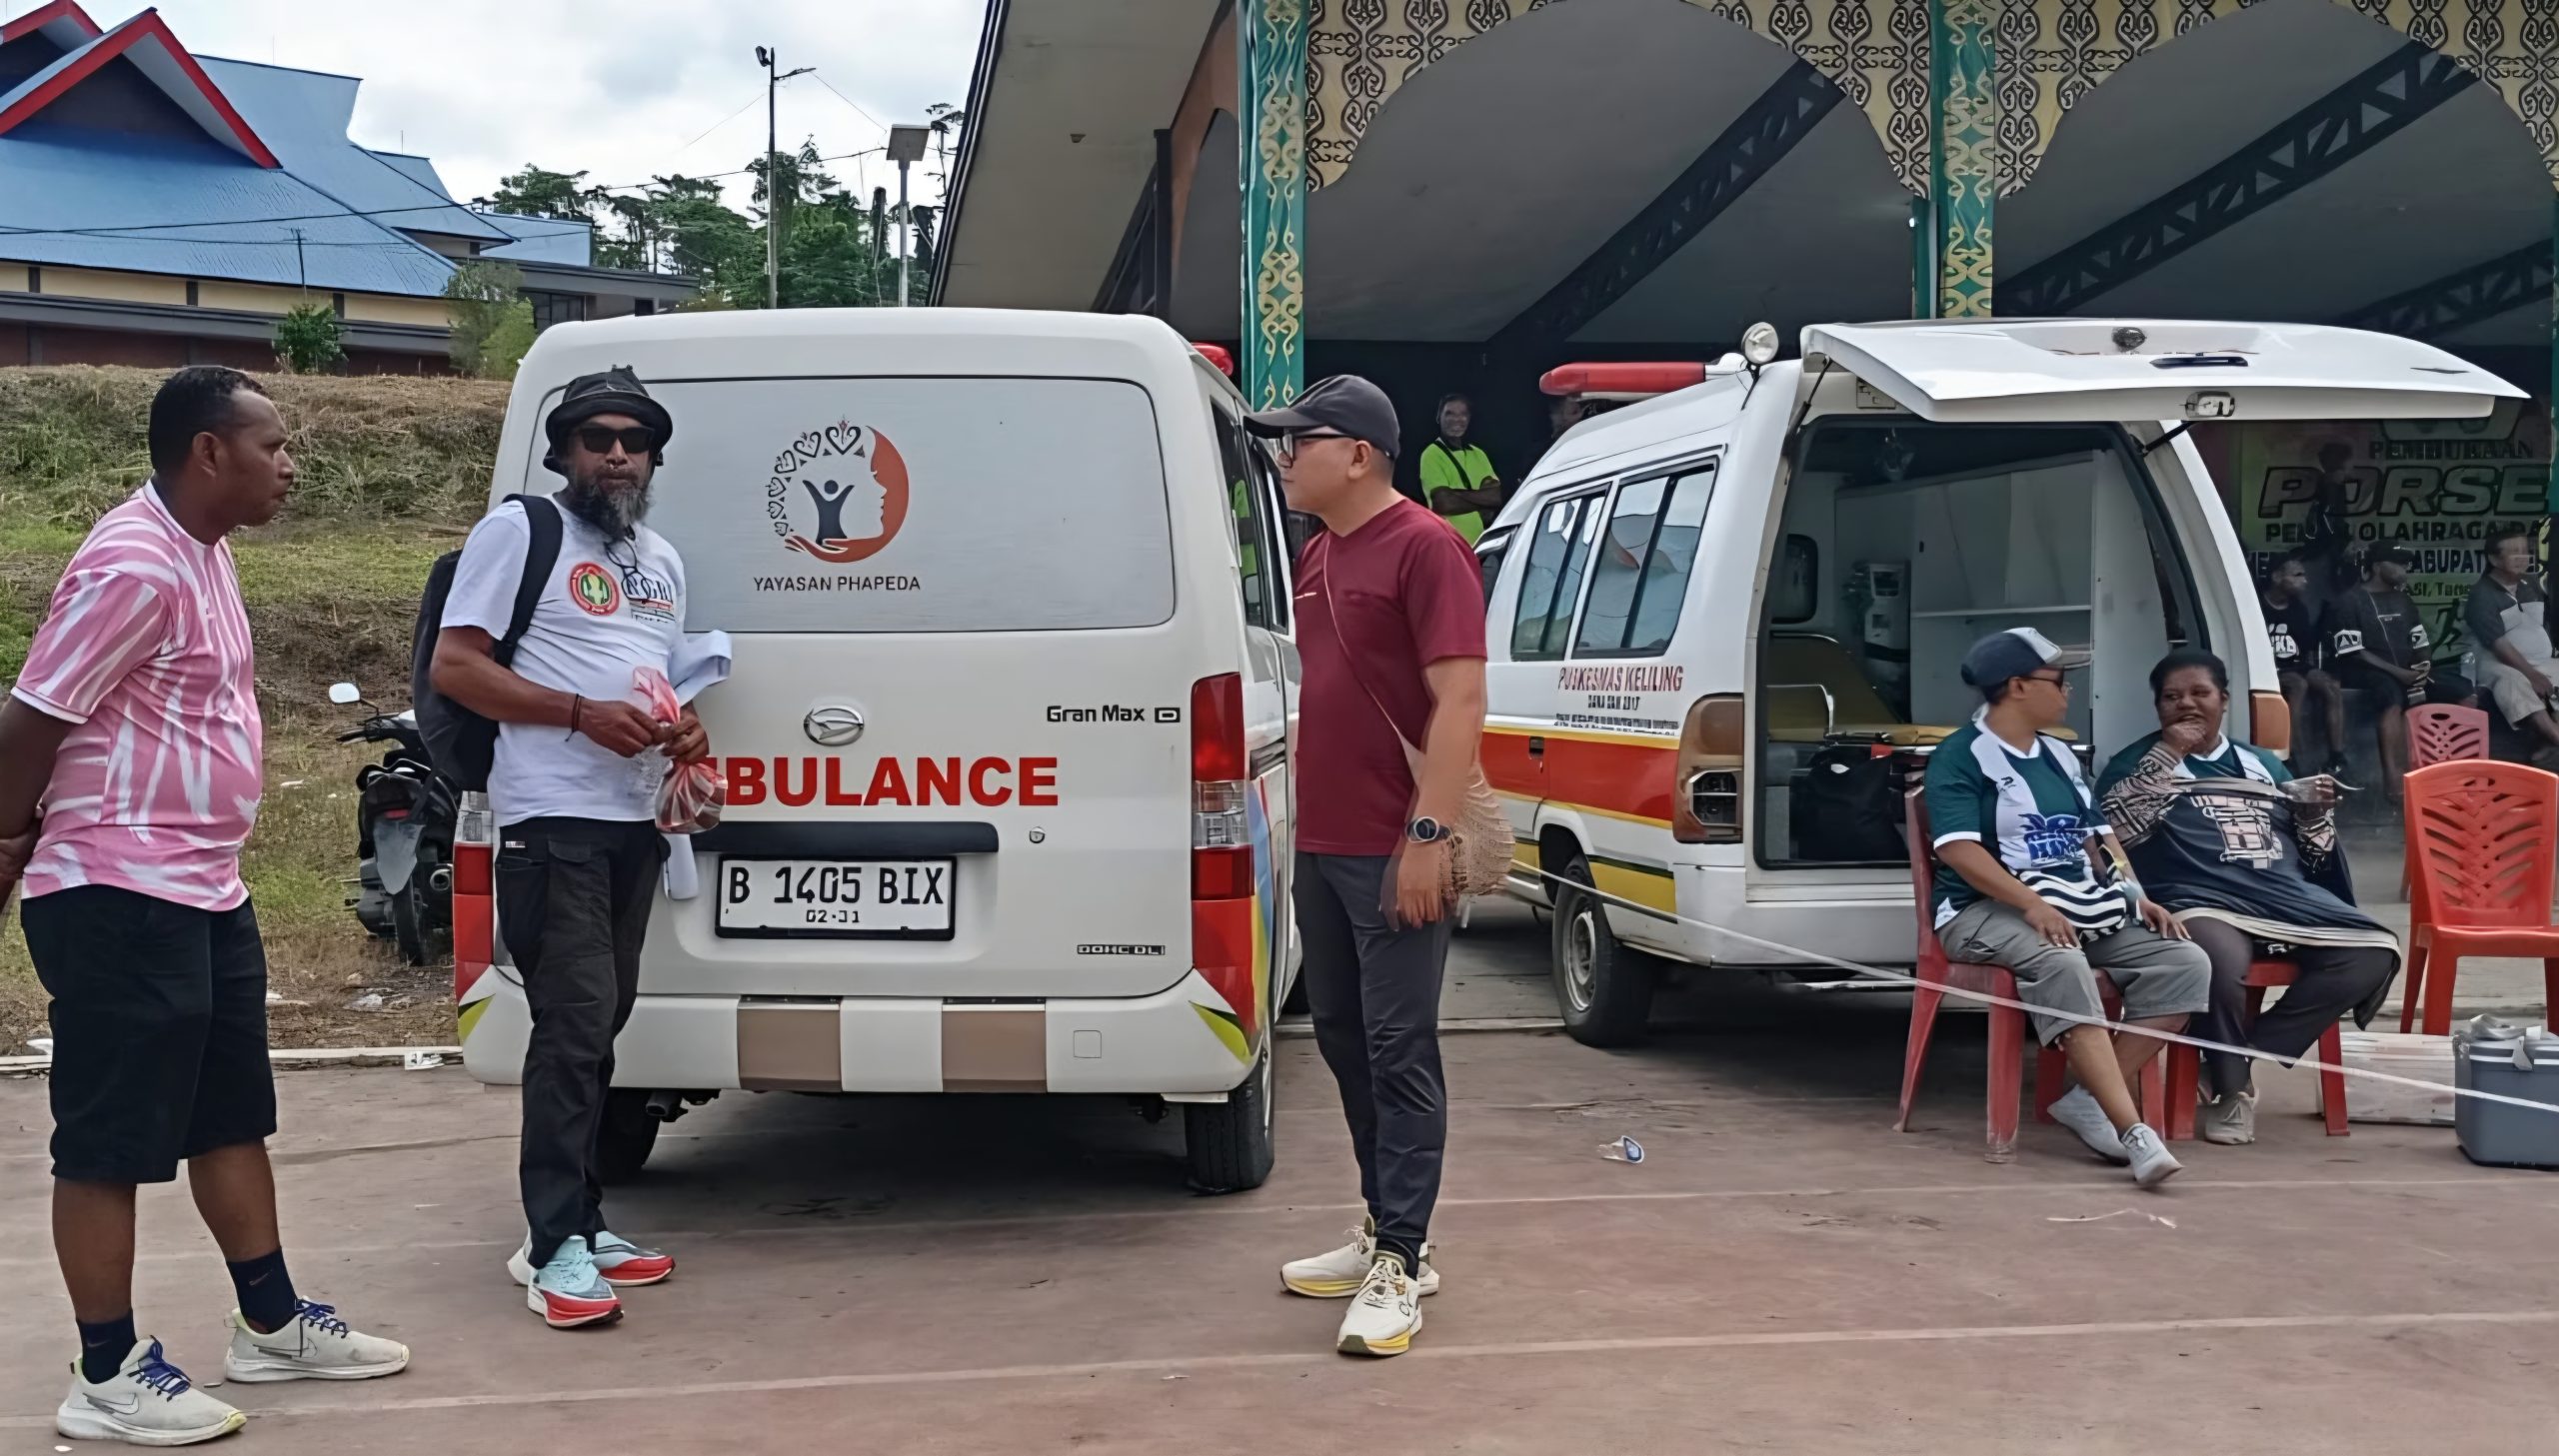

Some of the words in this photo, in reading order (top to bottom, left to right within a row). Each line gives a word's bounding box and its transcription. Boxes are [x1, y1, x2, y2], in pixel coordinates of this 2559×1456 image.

[753, 577, 832, 591] YAYASAN
[838, 576, 921, 591] PHAPEDA
[1624, 666, 1684, 692] KELILING
[1047, 706, 1097, 722] Gran
[1102, 705, 1146, 722] Max
[704, 756, 1059, 806] BULANCE
[730, 867, 750, 903] B
[774, 866, 863, 903] 1405
[879, 867, 944, 904] BIX
